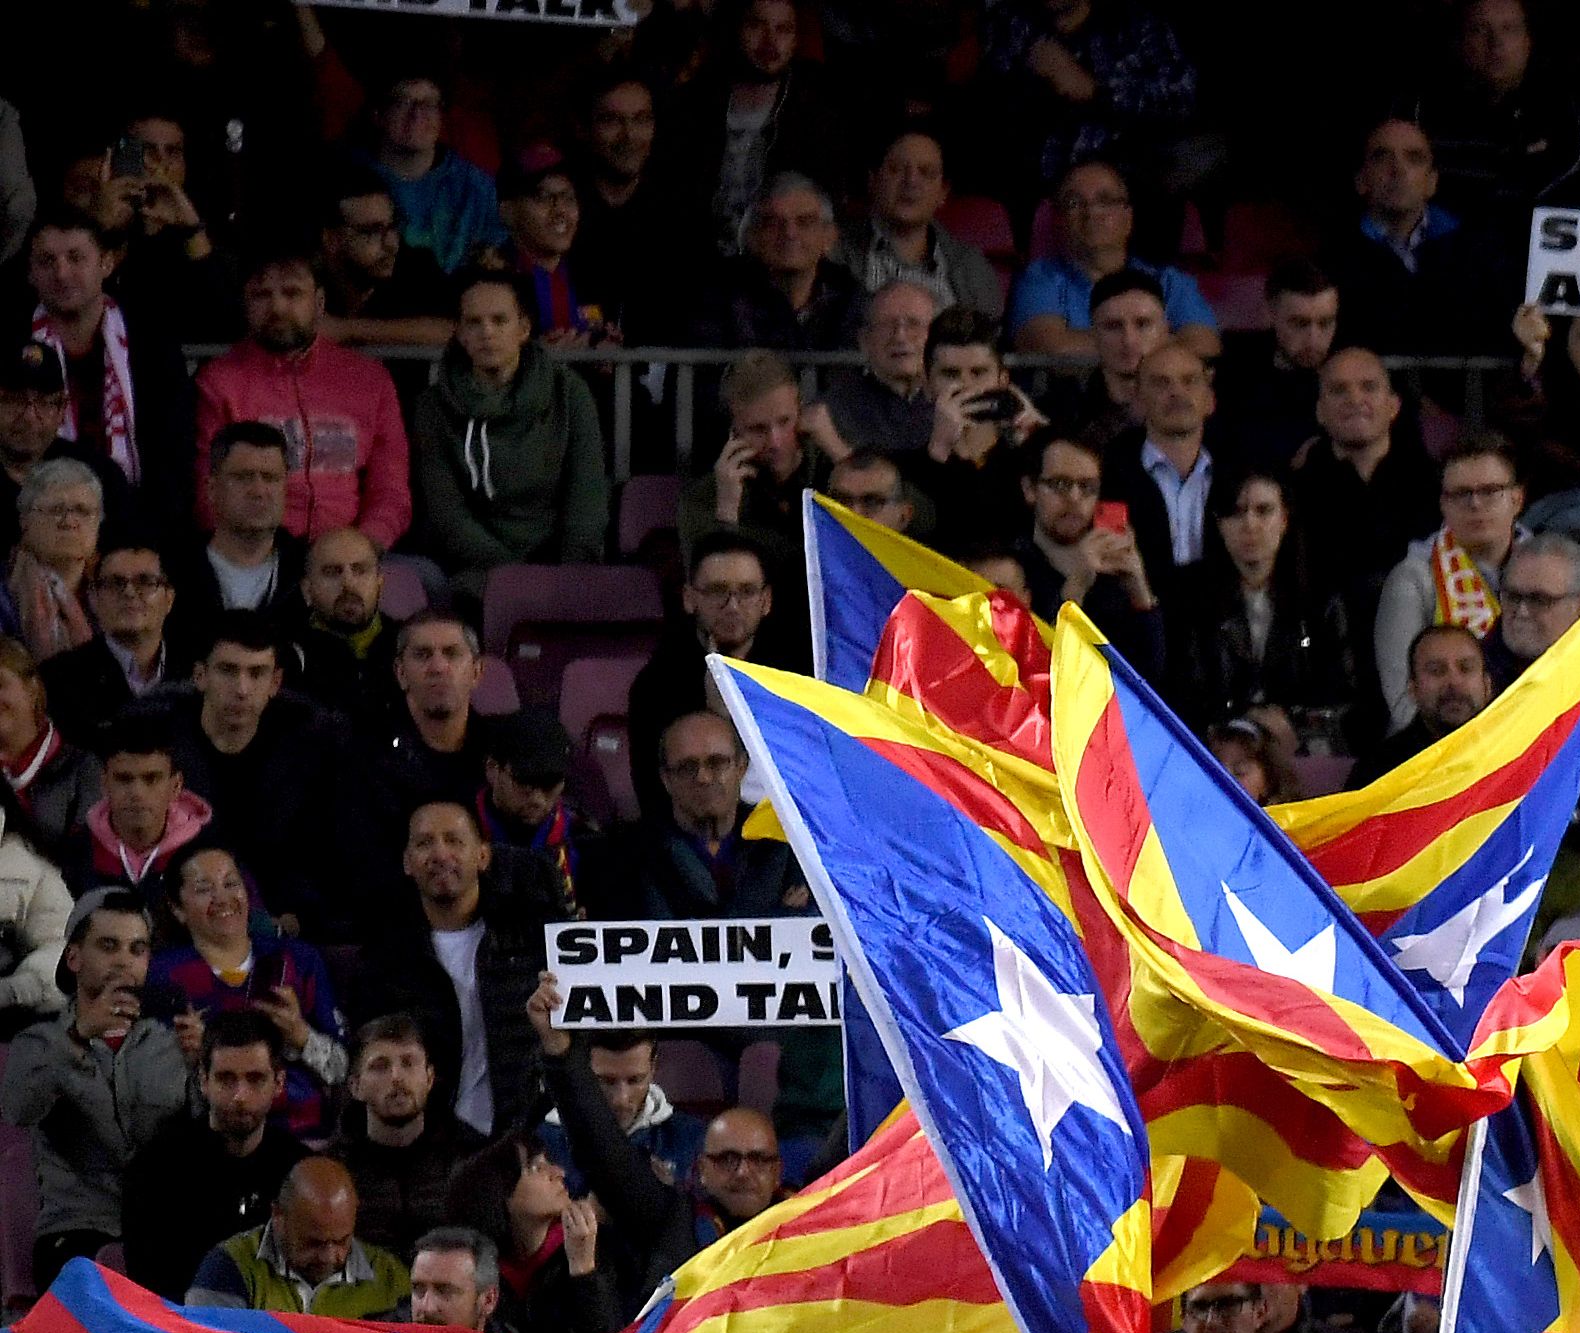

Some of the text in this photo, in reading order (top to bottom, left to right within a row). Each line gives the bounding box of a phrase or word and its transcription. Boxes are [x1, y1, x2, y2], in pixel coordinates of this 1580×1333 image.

[556, 925, 792, 970] SPAIN,
[562, 982, 841, 1024] AND TA
